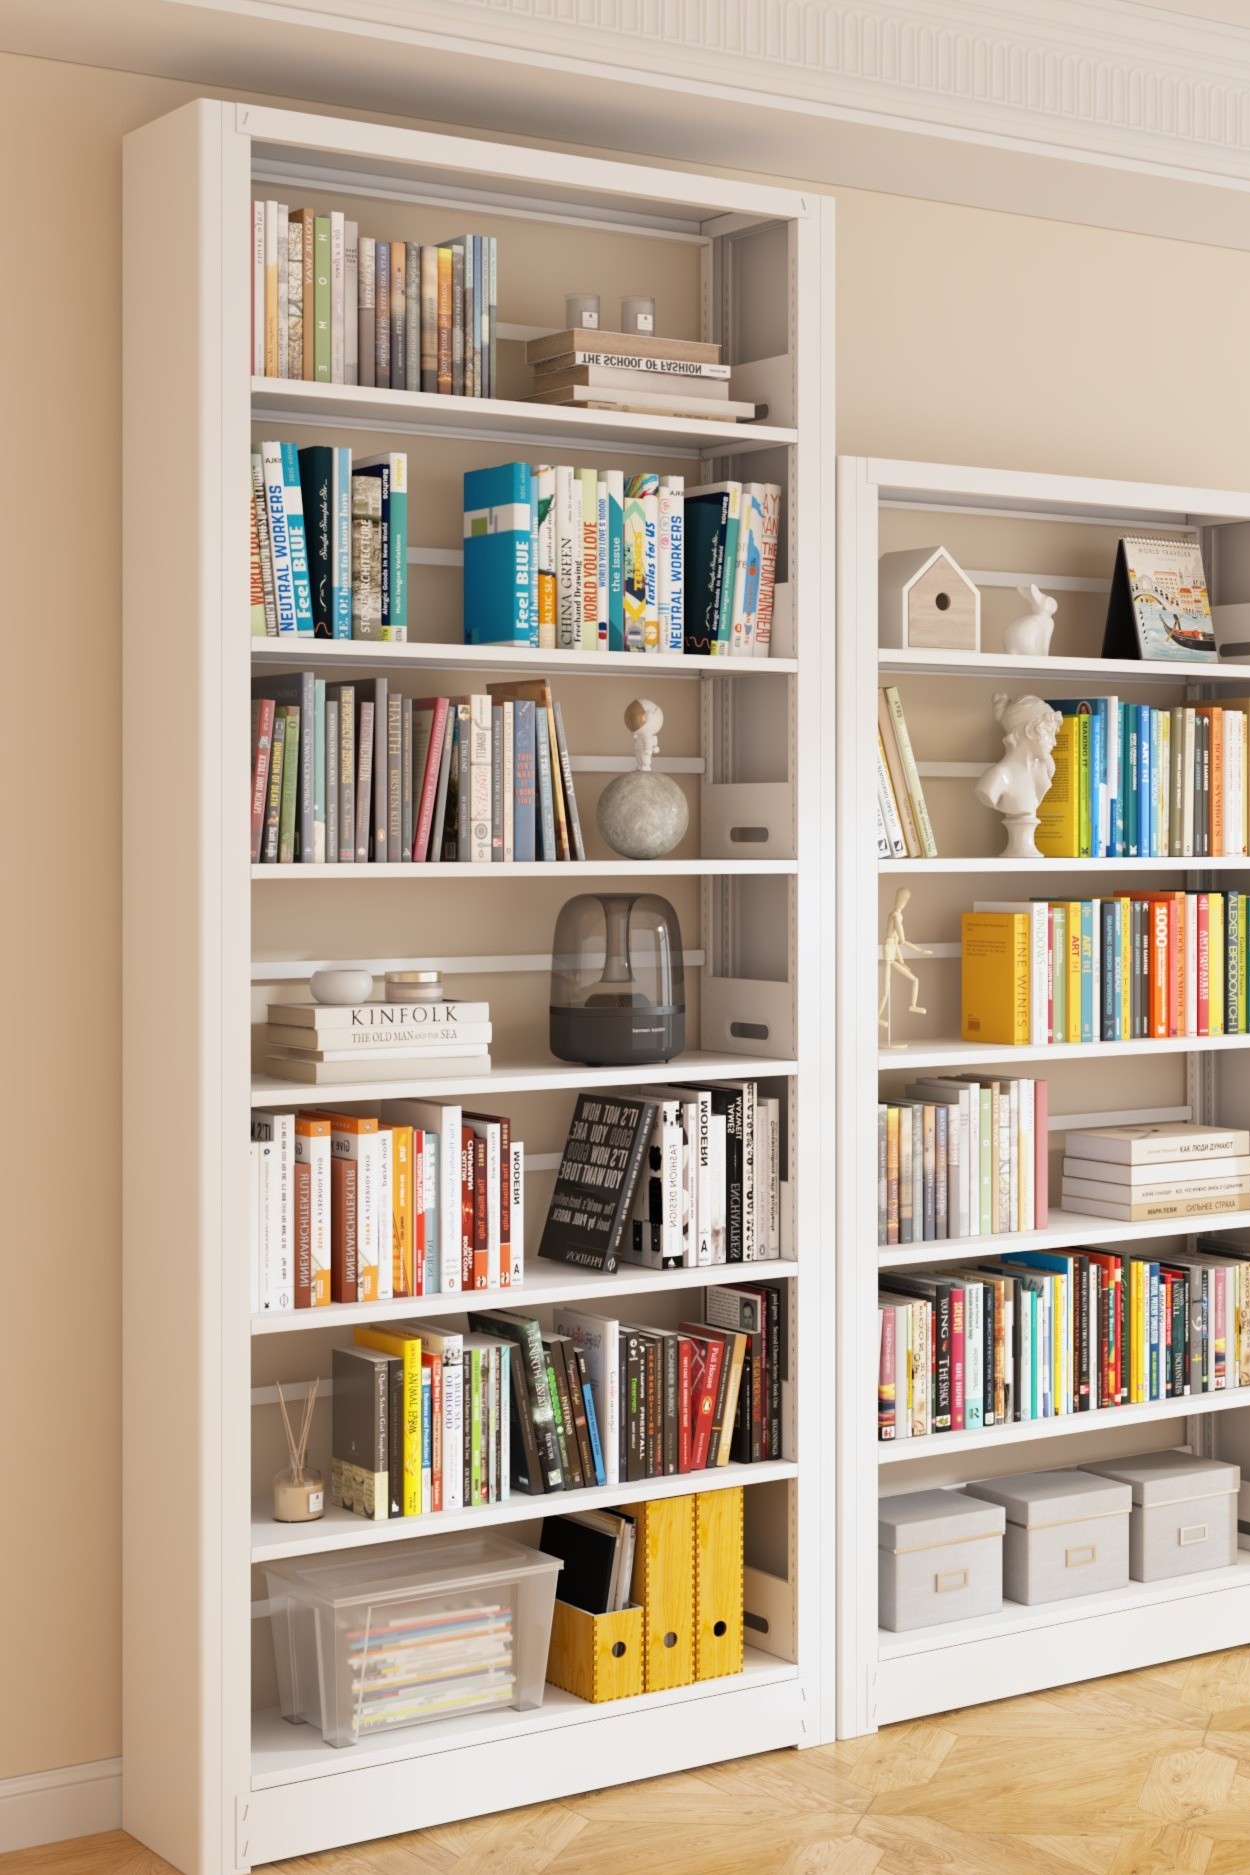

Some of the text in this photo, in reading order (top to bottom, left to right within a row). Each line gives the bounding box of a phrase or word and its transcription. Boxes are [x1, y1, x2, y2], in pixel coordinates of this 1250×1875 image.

[269, 485, 286, 559] WORKERS
[290, 525, 311, 619] Feel BLUE
[584, 522, 597, 622] WORLD YOU LOVE
[612, 537, 621, 592] the issue
[646, 522, 656, 606] Textiles for US
[1138, 548, 1160, 556] WORLD
[276, 564, 295, 633] NEUTRAL
[516, 541, 529, 629] Feel BLUE
[560, 538, 573, 646] CHINA GREEN
[574, 560, 582, 643] Freehand Drawing
[670, 516, 683, 650] NEUTRAL WORKERS
[388, 702, 402, 837] HALITH KIRSTEN KELLY
[561, 751, 575, 798] TRINITY
[1082, 758, 1088, 768] IT
[1036, 907, 1046, 966] WINDOWS
[1072, 936, 1080, 958] ART
[1156, 906, 1168, 948] 1000
[1017, 932, 1028, 1027] FINE WINES
[1229, 894, 1238, 1025] ALEXEY BRODOVITCH
[352, 1006, 459, 1026] KINFOLK
[352, 1033, 371, 1043] THE
[372, 1032, 392, 1042] OLD
[394, 1030, 414, 1042] MAN
[440, 1029, 457, 1039] SEA
[1180, 1142, 1234, 1153] КАК ЛЮДИ ДУМАЮТ
[1148, 1206, 1178, 1216] МАРК ЛЕВИ
[1186, 1200, 1236, 1212] СИЛЬНЕЕ СТРАХА
[954, 1302, 963, 1334] SCREWED!
[1150, 1276, 1159, 1345] VIRTUAL PATIENT SIMULATOR
[446, 1375, 453, 1385] OF
[707, 1347, 719, 1389] Full House
[939, 1298, 950, 1407] YOUNG THE SHACK
[1174, 1352, 1183, 1394] ENCHANTRESS
[409, 1372, 418, 1434] ANIMAL FARM
[560, 1396, 573, 1436] INFERNO
